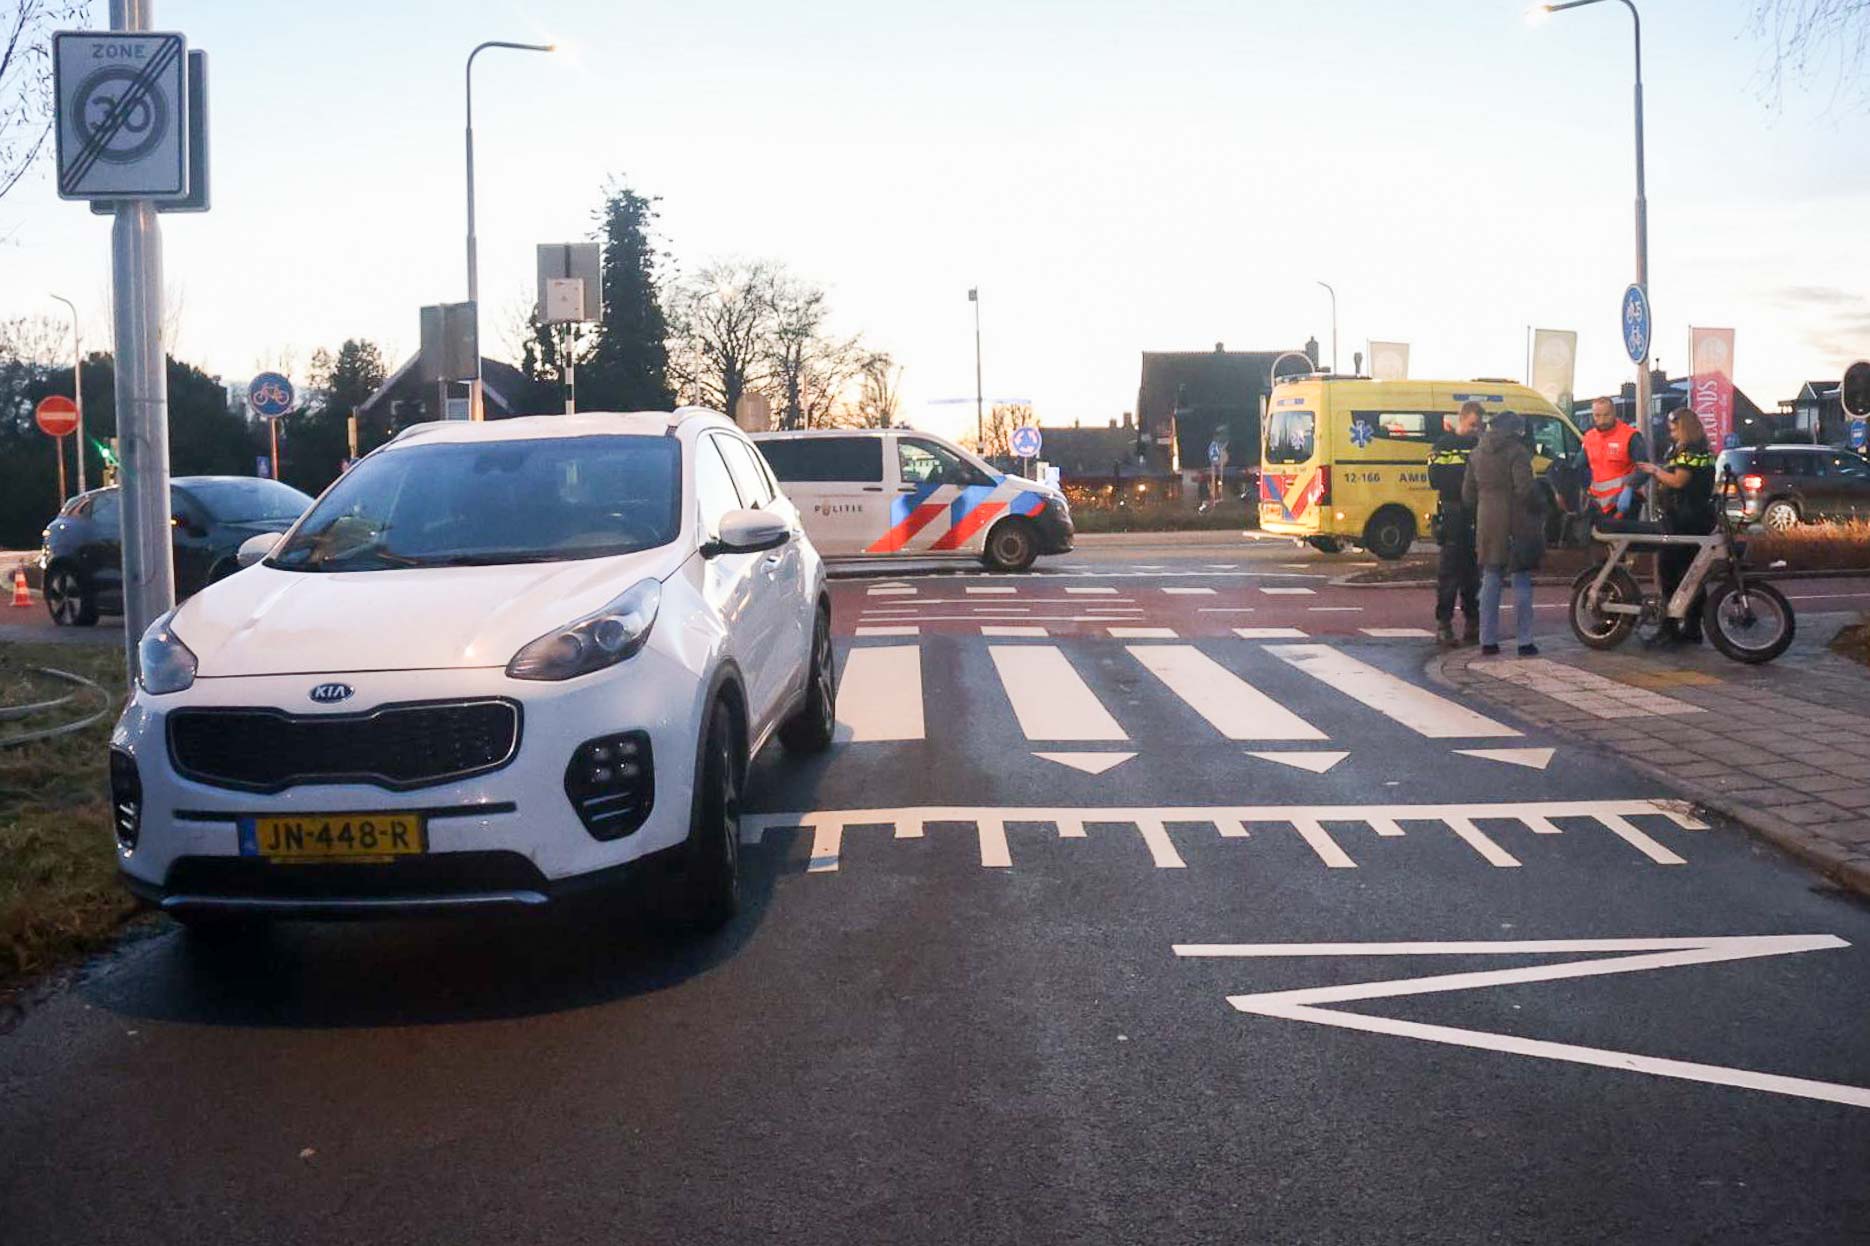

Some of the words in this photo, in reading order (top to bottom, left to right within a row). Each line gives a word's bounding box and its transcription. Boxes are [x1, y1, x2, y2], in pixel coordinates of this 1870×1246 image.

[92, 44, 146, 59] ZONE
[90, 96, 151, 133] 30
[814, 503, 863, 516] POLITIE
[315, 685, 346, 698] KIA
[267, 820, 409, 851] JN-448-R
